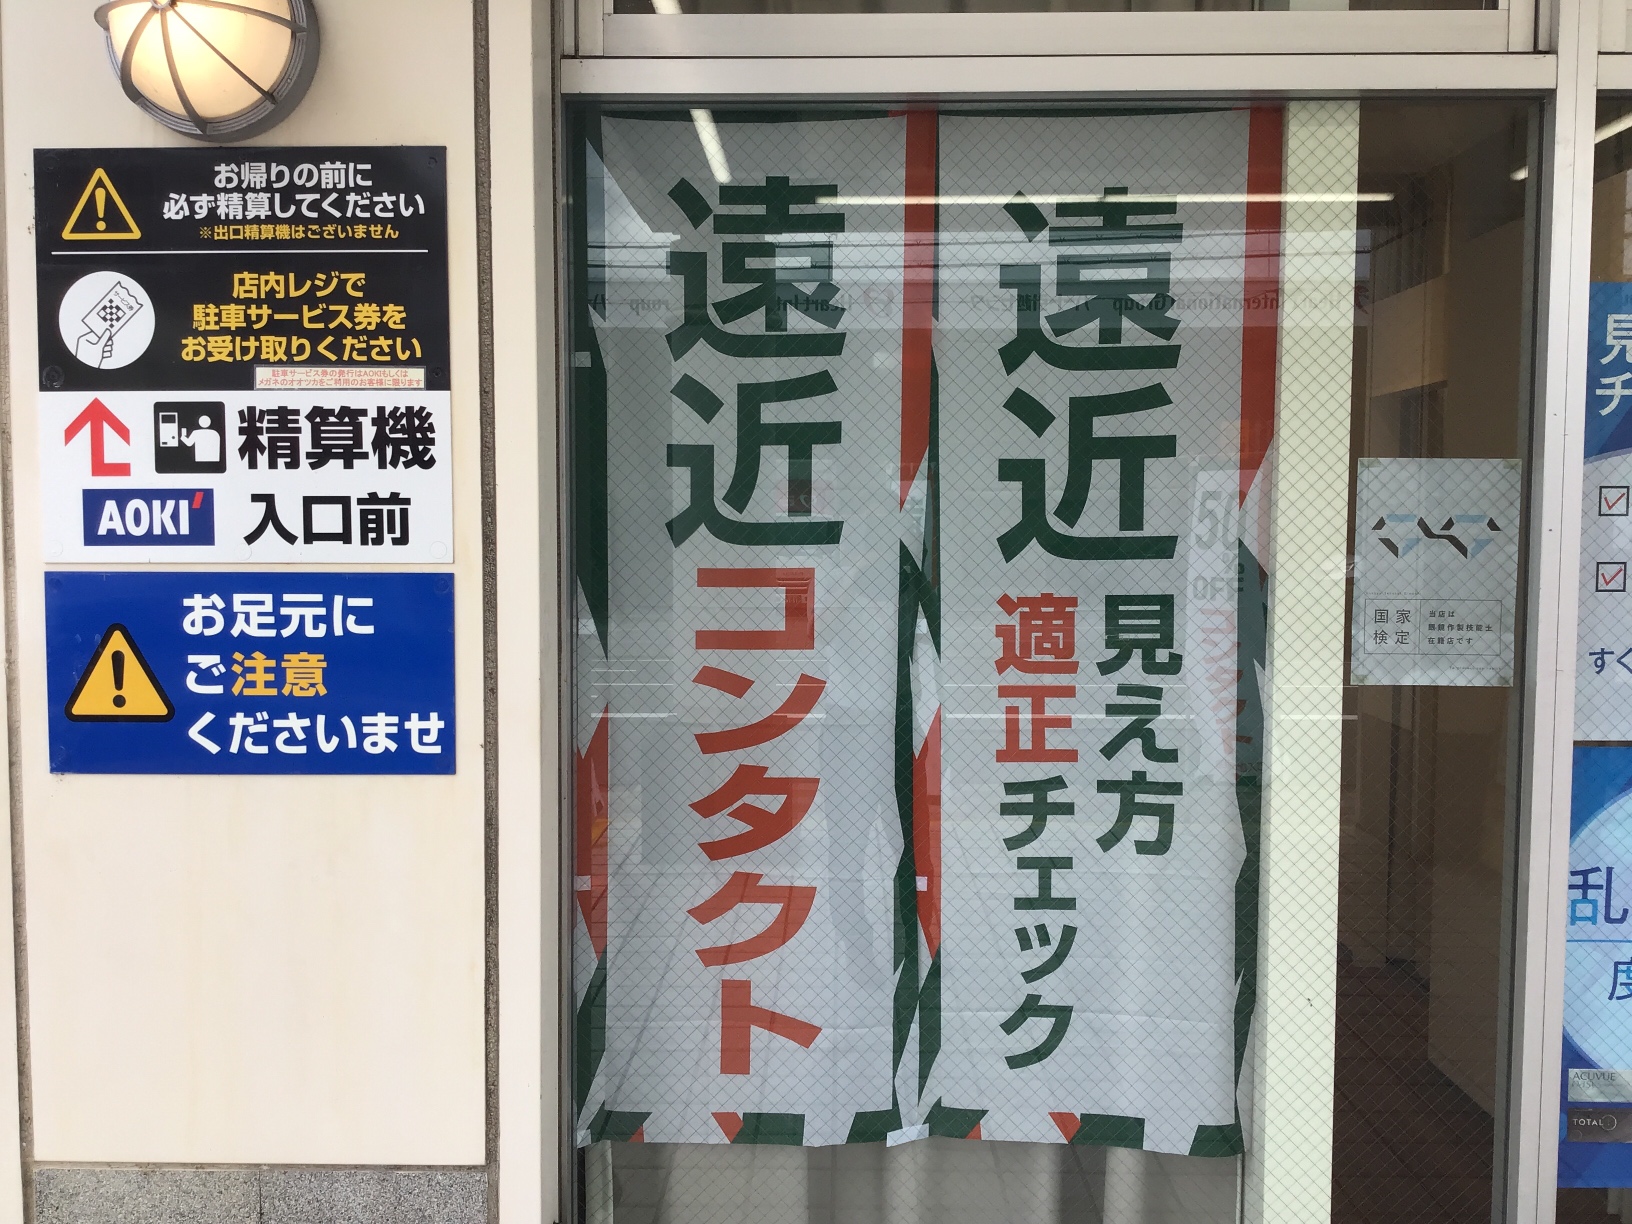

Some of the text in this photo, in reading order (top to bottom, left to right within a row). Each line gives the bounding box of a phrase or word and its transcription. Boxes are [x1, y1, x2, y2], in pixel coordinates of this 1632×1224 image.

[213, 161, 373, 190] お帰りの前に
[162, 192, 426, 220] 必ず精算してください
[199, 224, 399, 241] ※出口精算機はございません
[232, 271, 366, 299] 店内レジで
[192, 303, 407, 332] 駐車サービス券を
[181, 336, 422, 363] お受け取りください
[995, 187, 1184, 563] 遠近
[237, 405, 437, 471] 精算機
[243, 492, 412, 546] 入口前
[182, 593, 376, 638] お足元に
[185, 651, 328, 697] ご注意
[187, 711, 445, 755] くださいませ
[1096, 593, 1184, 856] 見え方
[994, 591, 1080, 1070] 適正チェック
